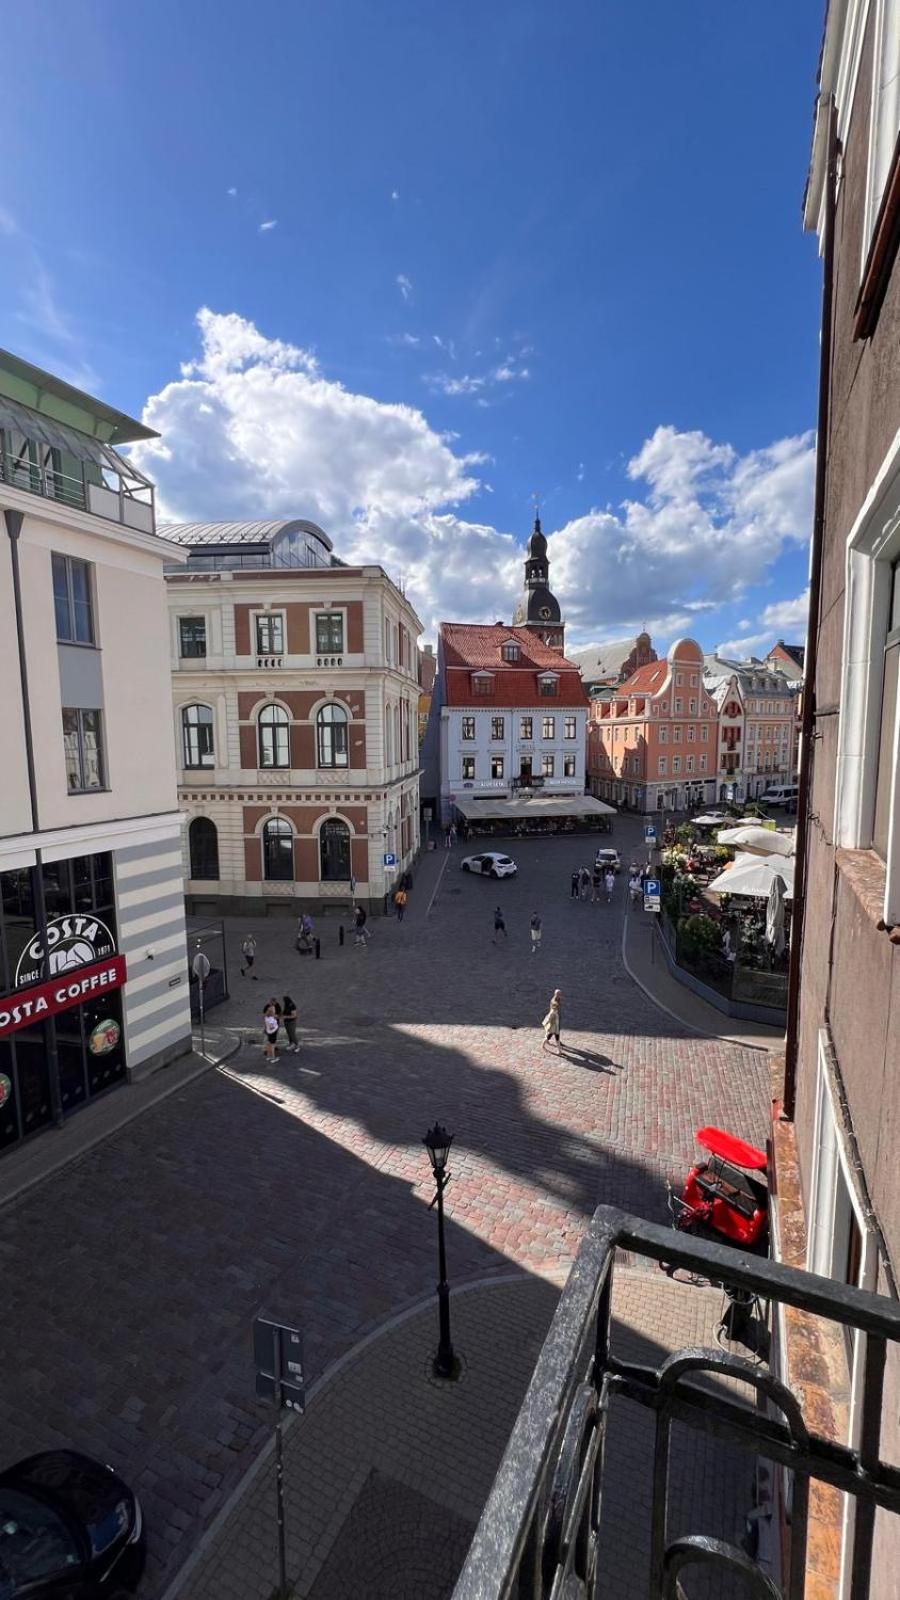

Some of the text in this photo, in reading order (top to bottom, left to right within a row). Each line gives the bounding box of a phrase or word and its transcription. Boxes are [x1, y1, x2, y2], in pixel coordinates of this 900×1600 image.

[647, 882, 657, 893] P
[29, 918, 99, 960] COSTA
[19, 969, 40, 984] SINCE
[55, 968, 117, 1003] COFFEE
